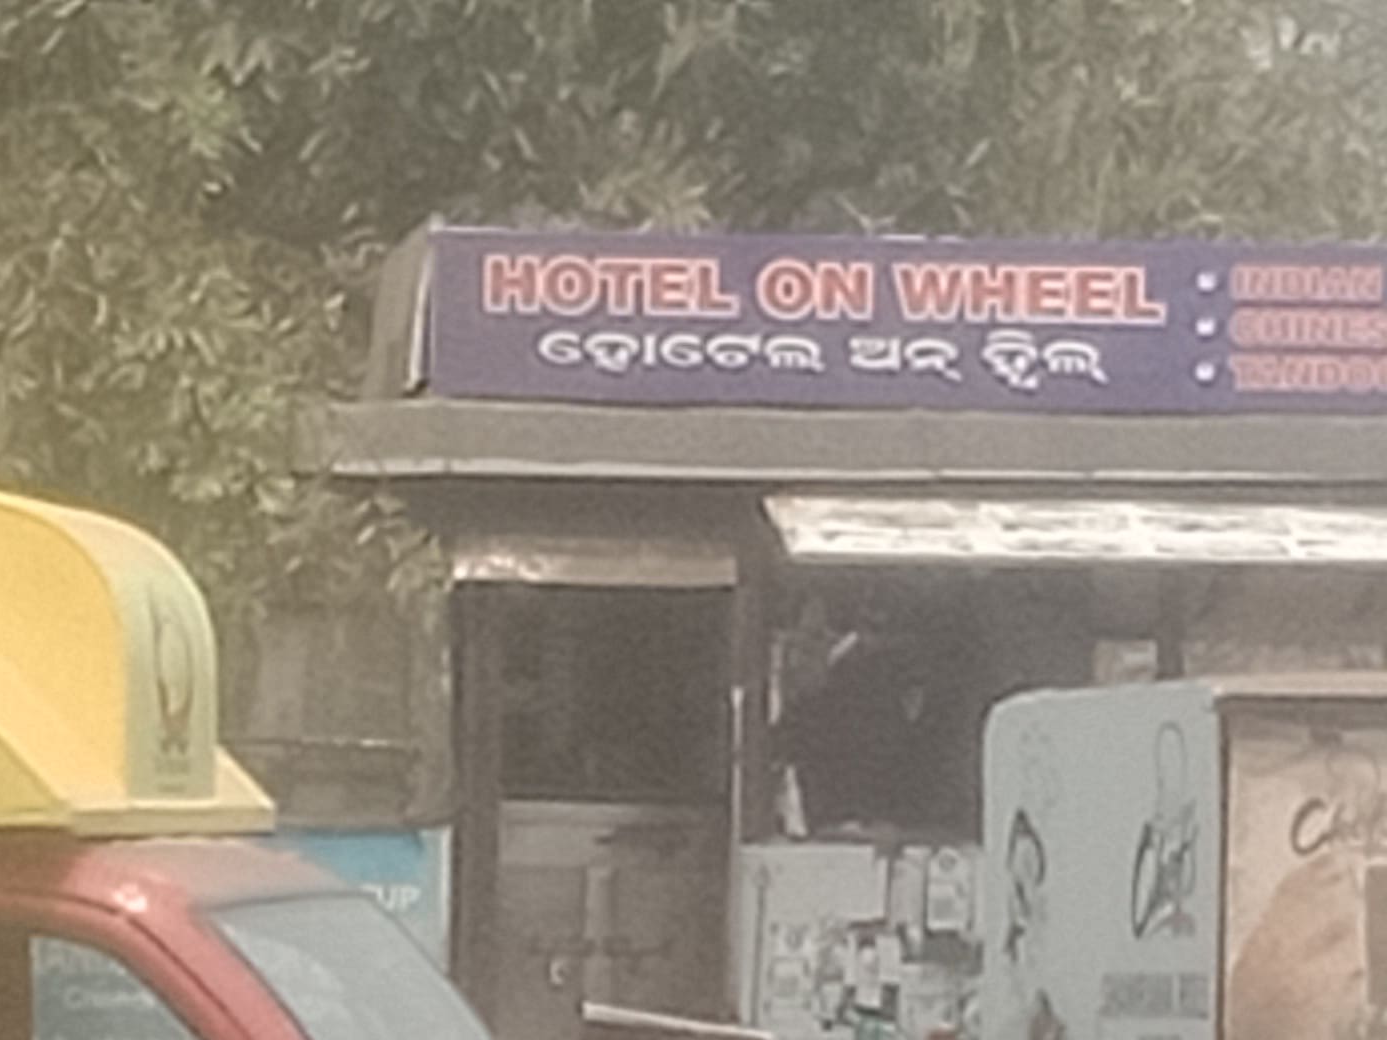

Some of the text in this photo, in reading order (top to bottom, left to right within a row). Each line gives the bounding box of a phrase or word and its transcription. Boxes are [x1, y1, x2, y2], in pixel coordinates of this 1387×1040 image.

[483, 255, 1168, 327] HOTEL ON WHEEL
[1229, 265, 1383, 301] INDIAN
